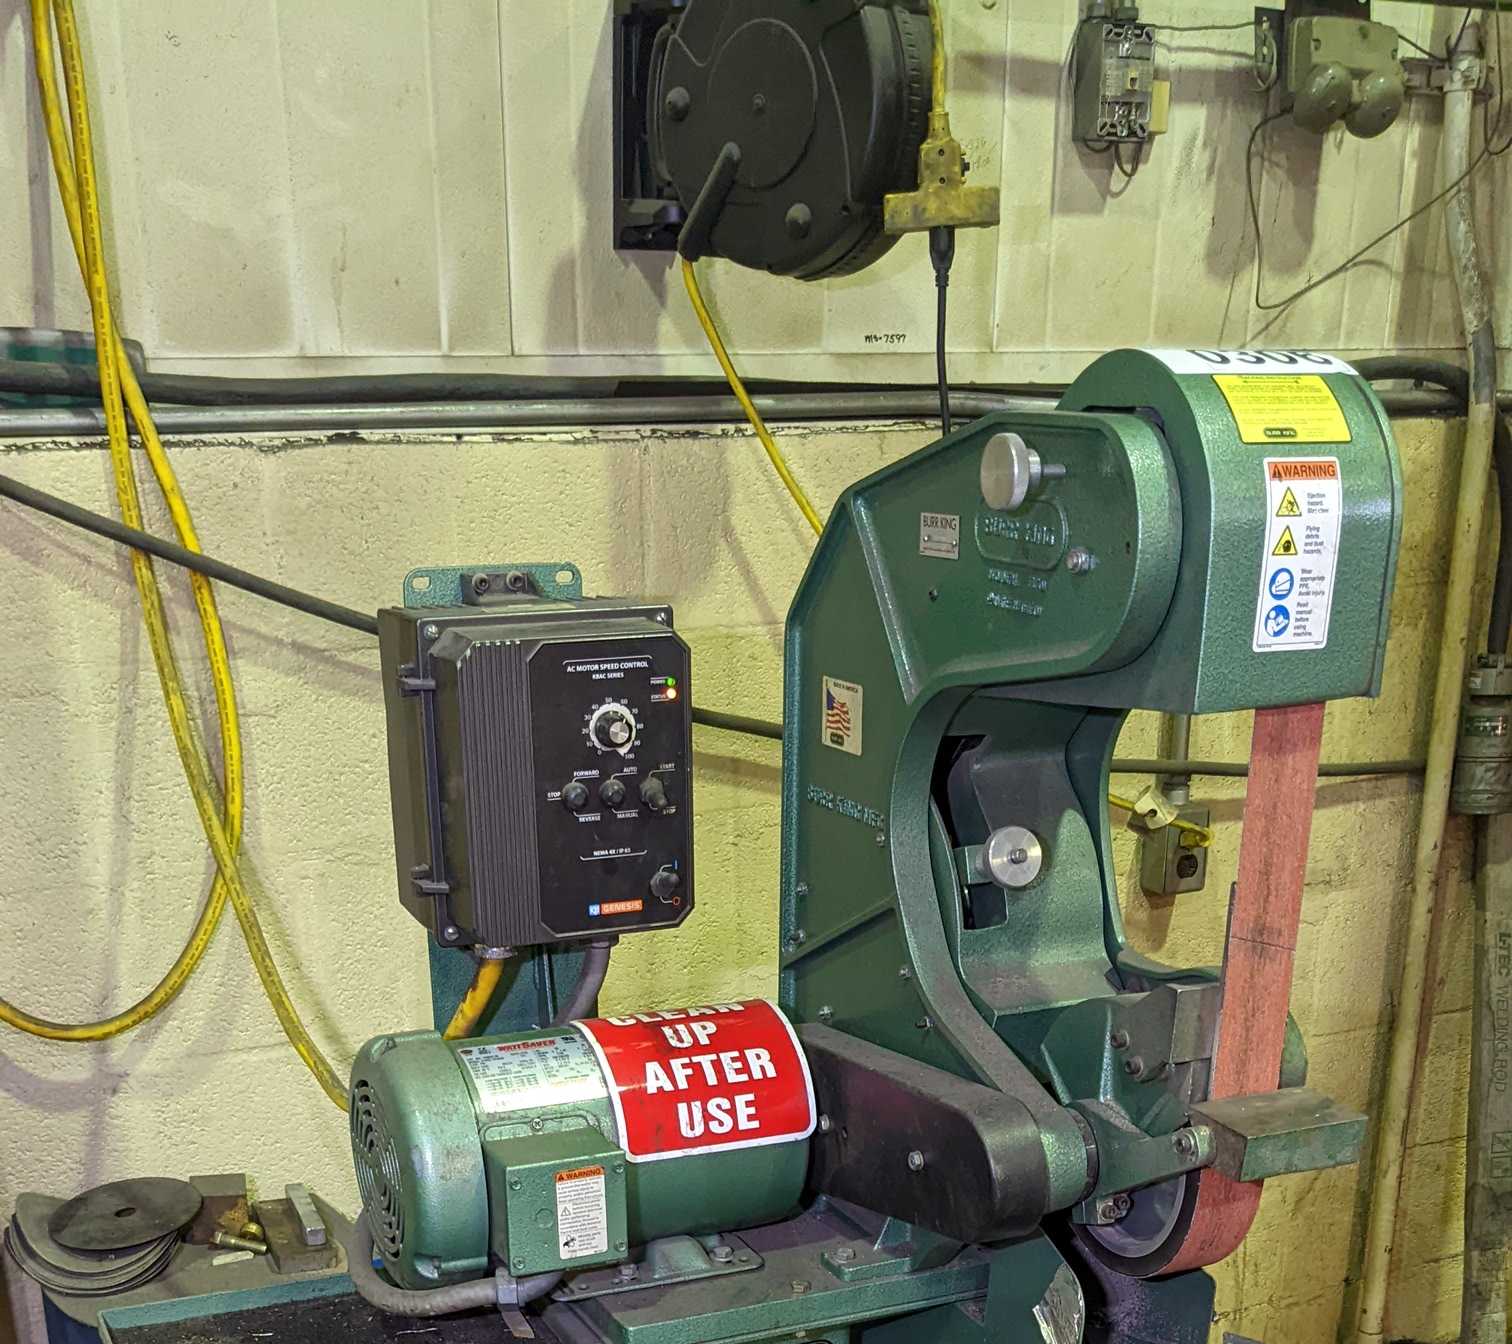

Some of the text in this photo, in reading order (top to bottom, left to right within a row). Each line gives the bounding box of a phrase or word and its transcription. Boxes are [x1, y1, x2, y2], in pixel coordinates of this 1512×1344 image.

[1282, 464, 1336, 479] WARNING
[923, 515, 956, 530] BURR KING
[566, 661, 648, 673] AC MOTOR SPEED CONTROL
[603, 900, 642, 914] GENESIS
[661, 1021, 717, 1048] UP
[645, 1048, 777, 1095] AFTER
[676, 1094, 760, 1138] USE
[566, 1168, 602, 1179] WARNING
